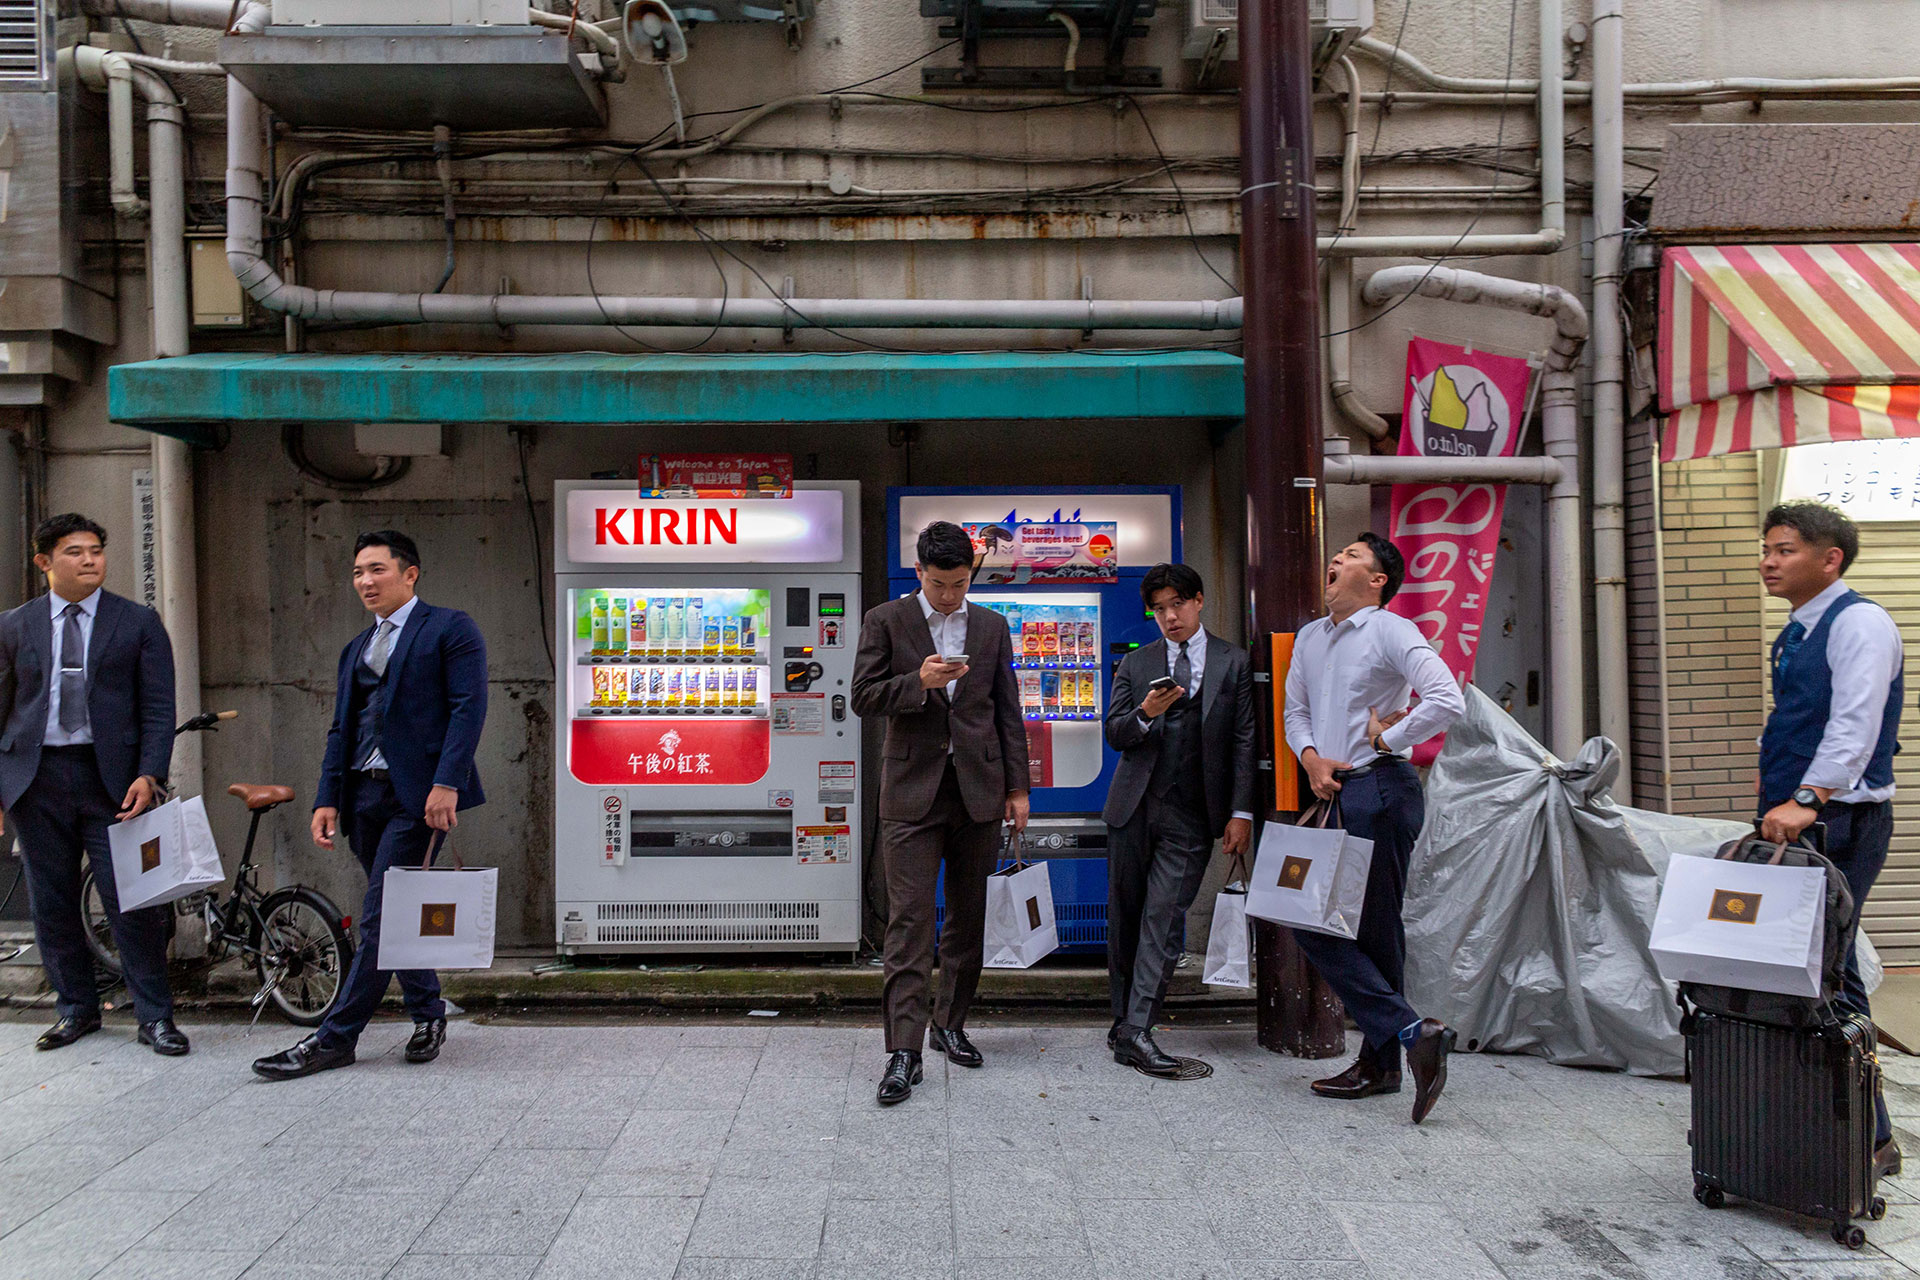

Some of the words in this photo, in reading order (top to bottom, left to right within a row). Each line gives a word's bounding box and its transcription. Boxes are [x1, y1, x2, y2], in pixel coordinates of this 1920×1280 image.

[663, 460, 713, 469] Welcome
[719, 460, 731, 469] to
[736, 458, 770, 470] Japan
[595, 508, 738, 545] KIRIN
[1022, 527, 1034, 535] Get
[1036, 527, 1055, 536] tasty
[1022, 536, 1061, 545] beverages
[1063, 535, 1083, 544] here!
[627, 753, 711, 775] 午後の紅茶
[473, 874, 496, 966] ArtGrace
[1782, 870, 1821, 959] ArtGrace
[992, 958, 1019, 966] ArtGrace
[1212, 975, 1241, 985] ArtGrace
